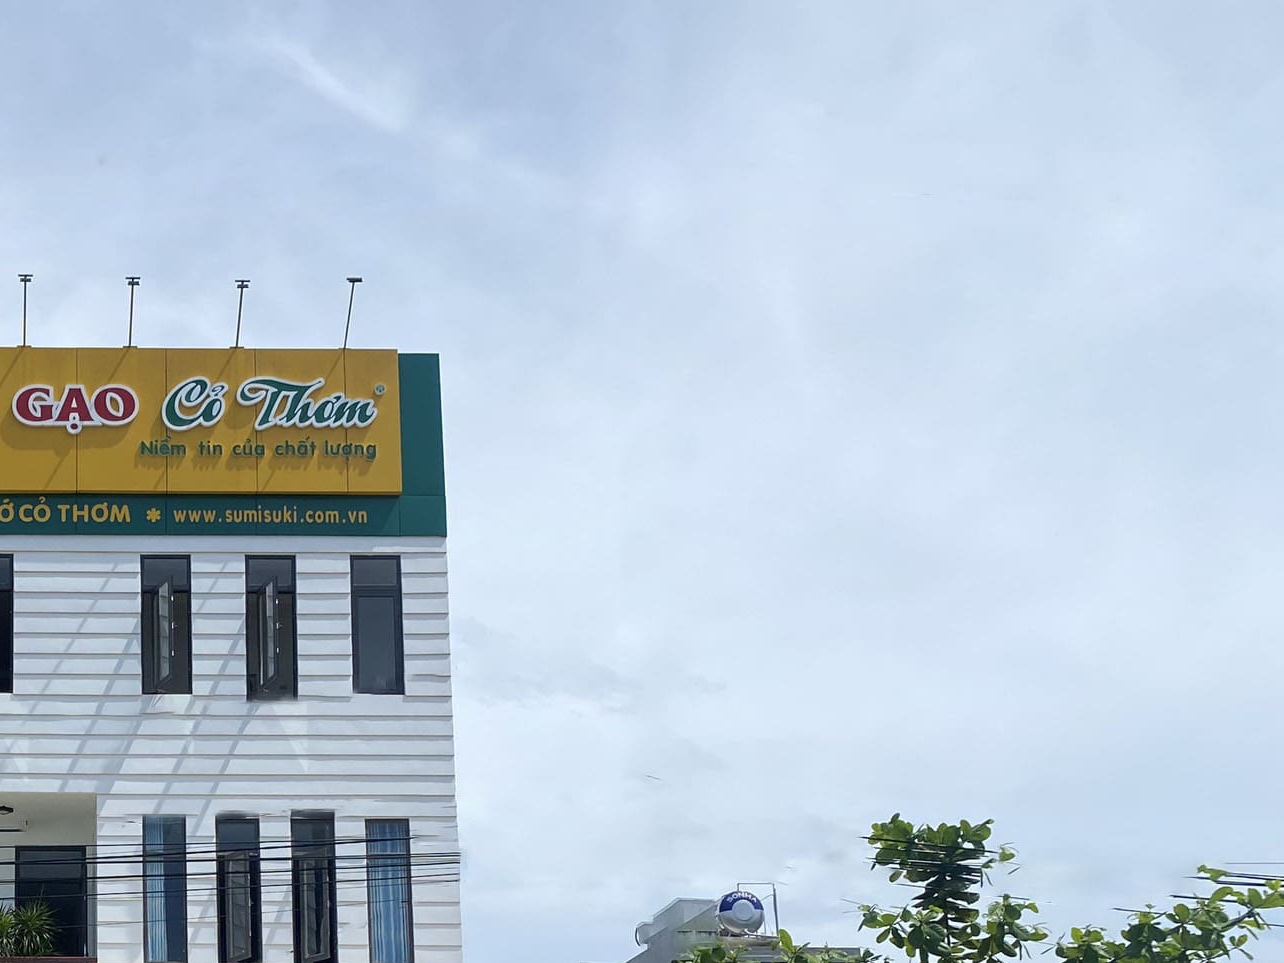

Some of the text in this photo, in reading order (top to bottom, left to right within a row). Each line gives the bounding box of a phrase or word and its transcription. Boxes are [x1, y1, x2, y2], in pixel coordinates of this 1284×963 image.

[12, 376, 378, 434] GẠO Cỏ Thơm
[140, 435, 377, 460] Niềm tin của chất lượng
[19, 496, 52, 523] CỎ
[58, 501, 132, 523] THƠM
[173, 504, 369, 525] www.sumisuki.com.vn
